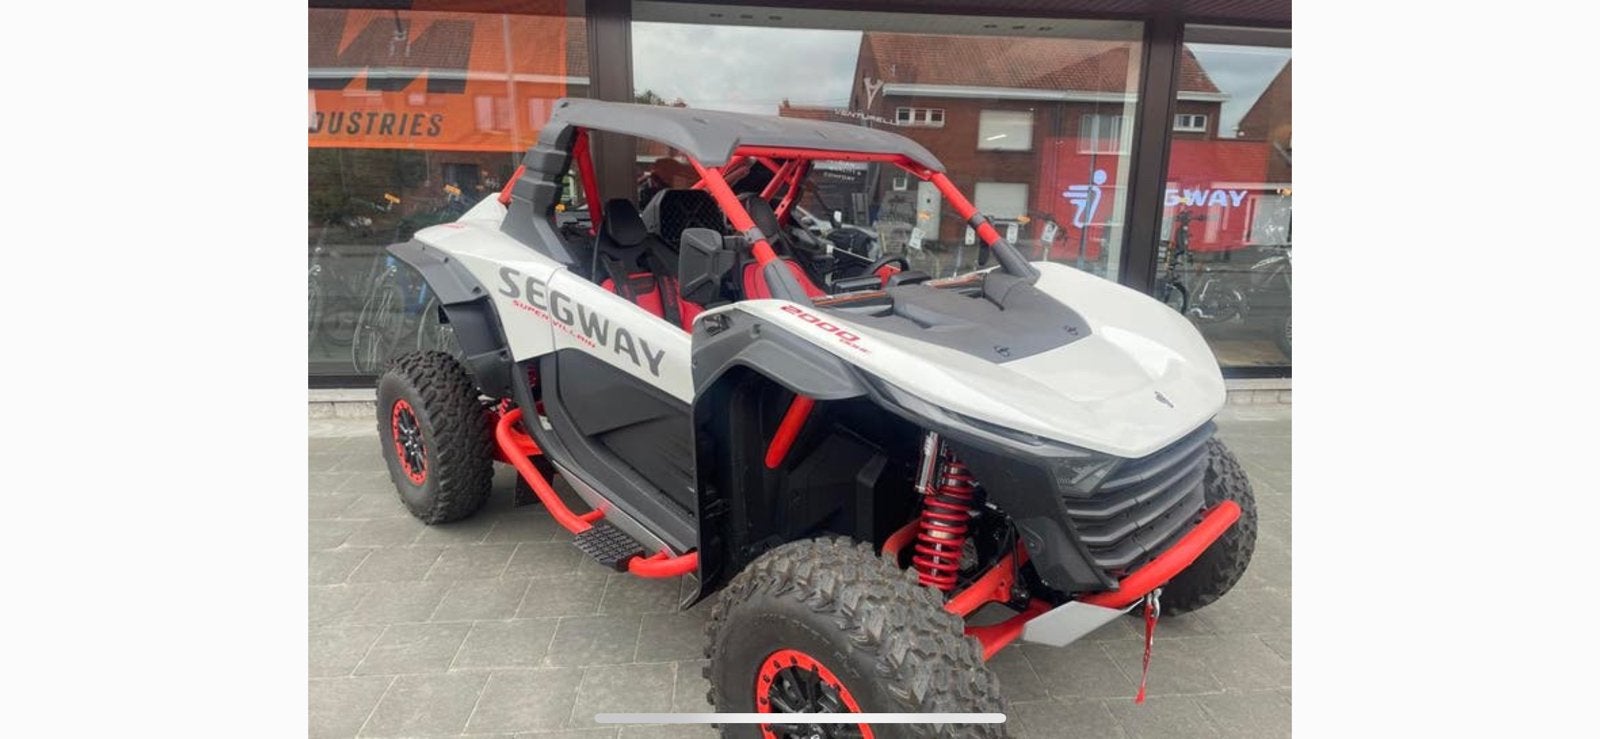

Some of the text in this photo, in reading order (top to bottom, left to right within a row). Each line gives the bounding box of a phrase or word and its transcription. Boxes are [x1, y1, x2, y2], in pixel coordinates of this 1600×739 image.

[498, 266, 665, 377] SEGWAY
[512, 299, 596, 348] SUPER VILLAIN
[779, 304, 861, 342] 2000
